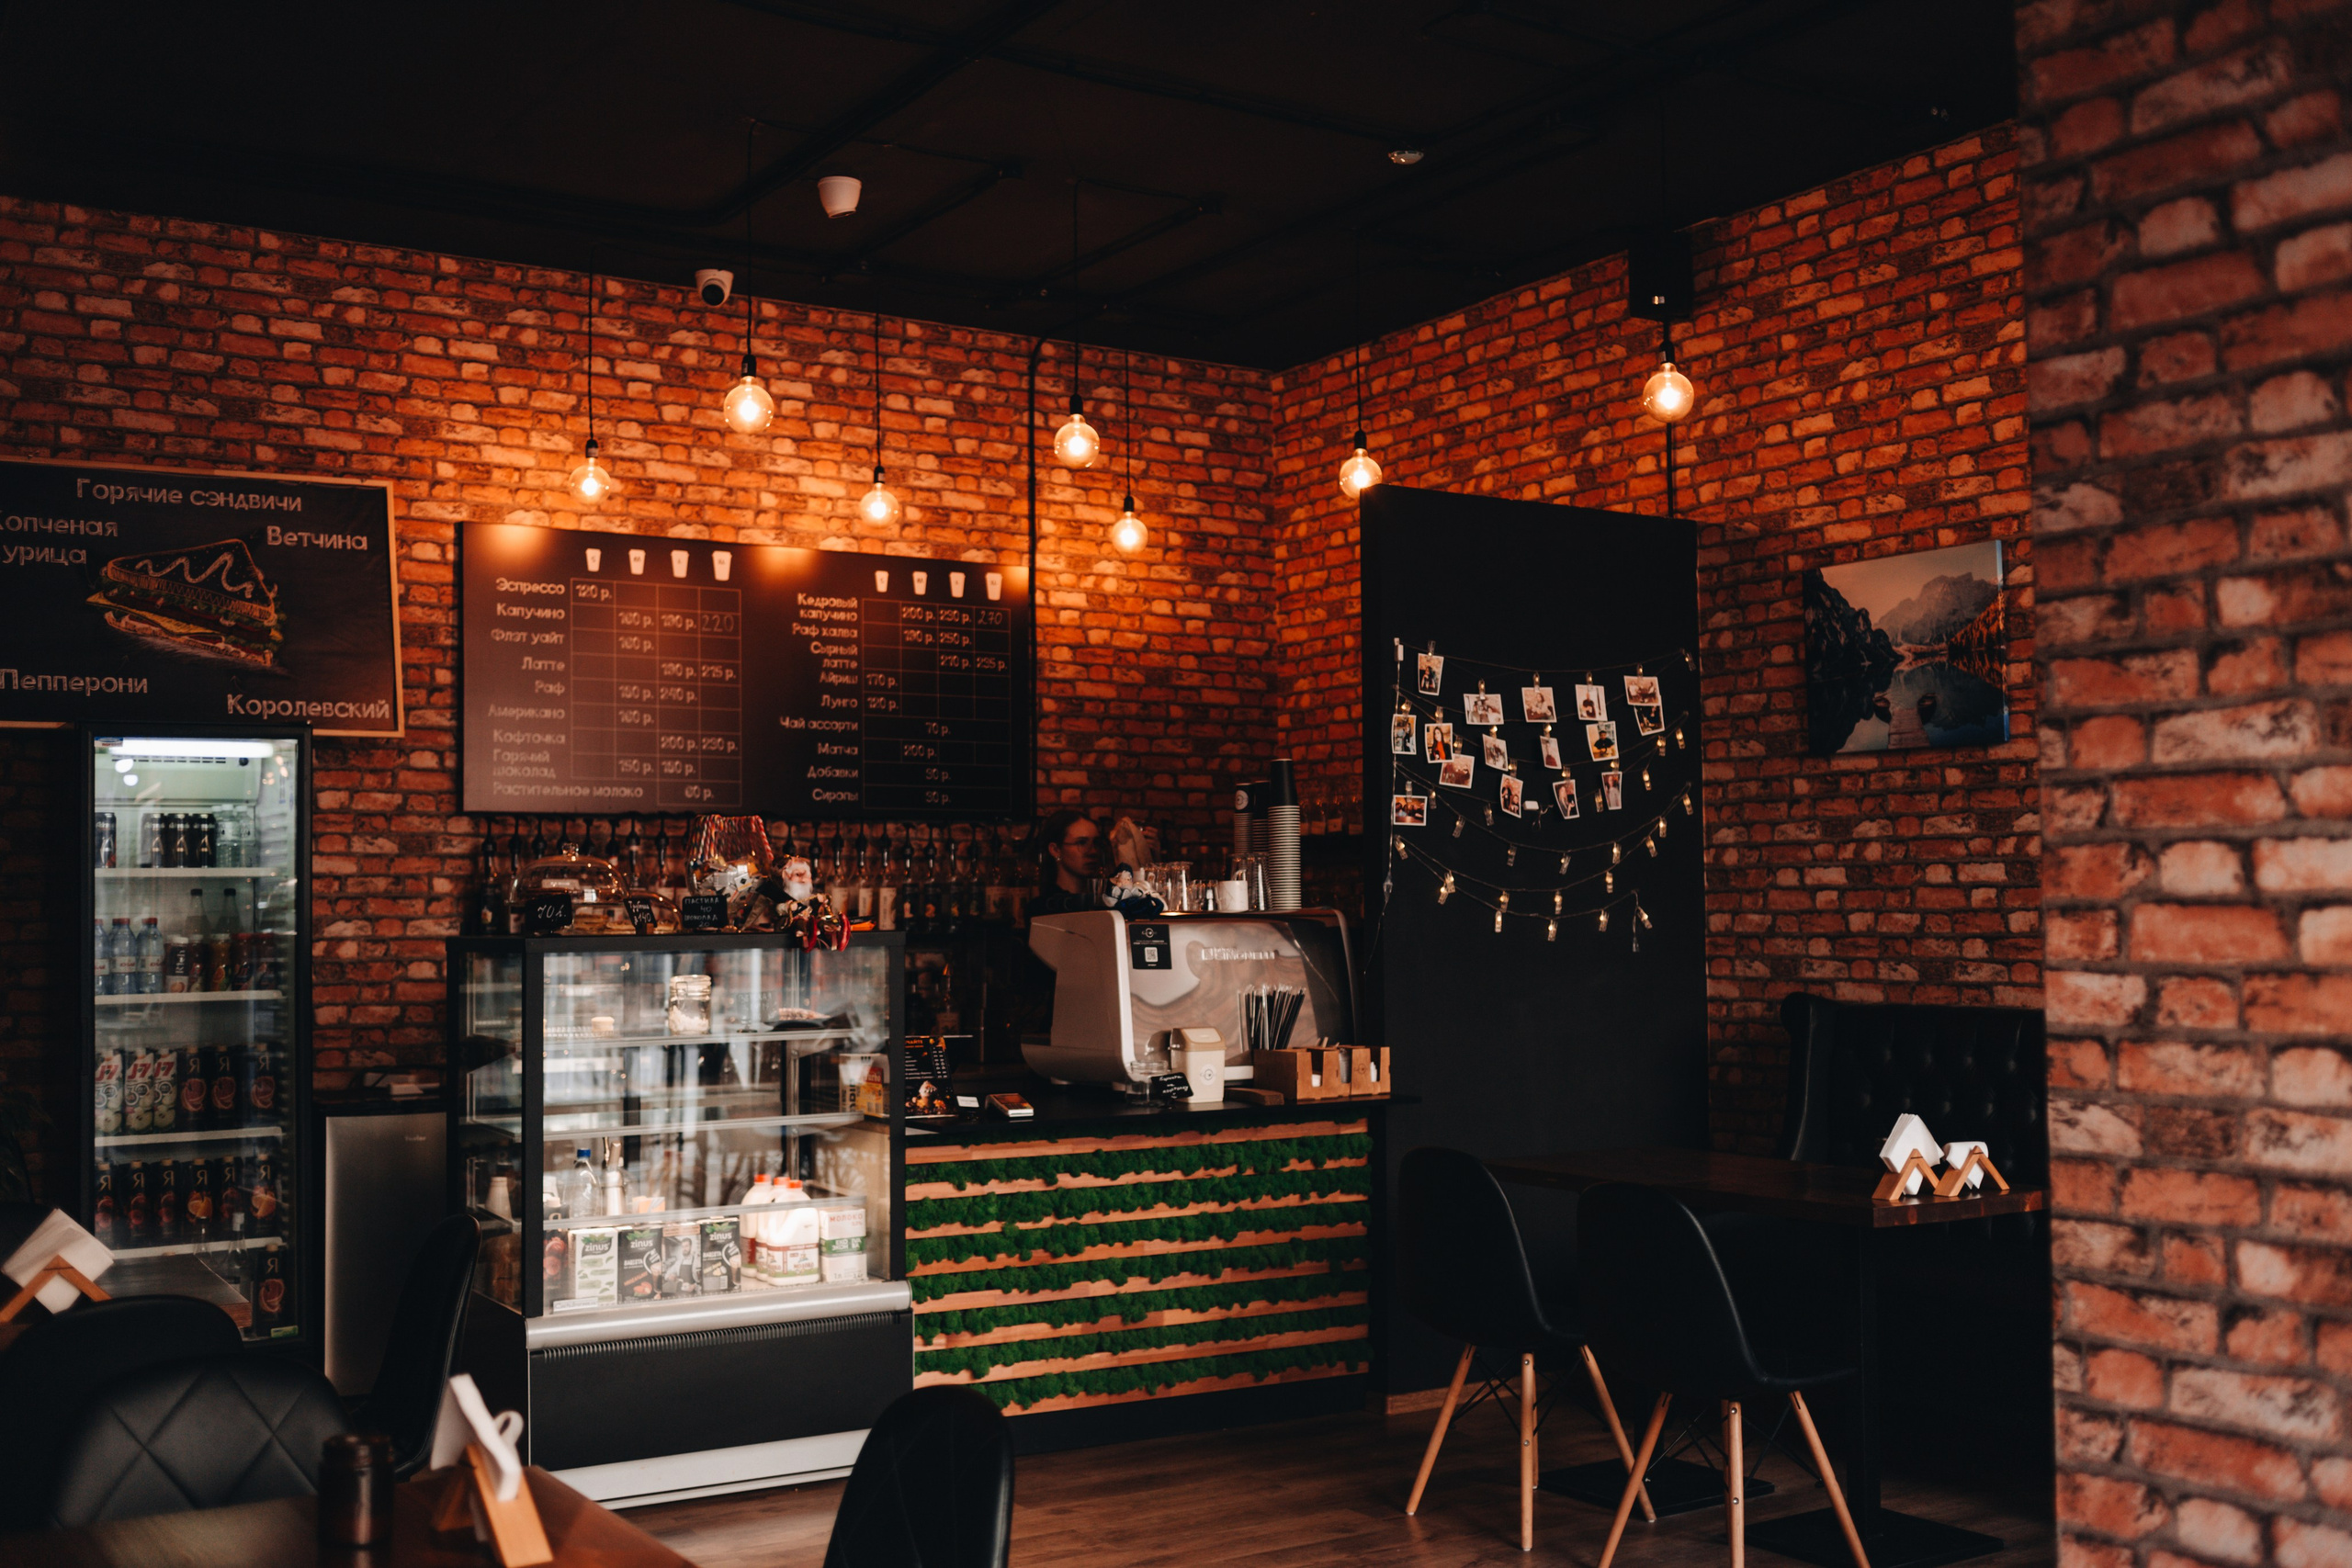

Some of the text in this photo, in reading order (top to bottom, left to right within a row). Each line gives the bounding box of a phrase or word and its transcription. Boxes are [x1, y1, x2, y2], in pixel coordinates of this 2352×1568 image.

[76, 478, 301, 513] Горячие сэндвичи
[266, 525, 368, 551] Ветчина
[0, 545, 86, 566] урица
[495, 577, 565, 595] Эспрессо
[575, 584, 598, 598] 120
[797, 593, 857, 609] Кедровый
[496, 604, 565, 620] Капучино
[799, 609, 857, 623] капучино
[902, 608, 924, 621] 200
[978, 610, 1003, 625] 270
[701, 615, 734, 632] 220
[792, 623, 858, 638] Раф халва
[491, 627, 565, 645] Флэт уайт
[810, 641, 857, 656] Сырный
[522, 657, 565, 671] Латте
[822, 658, 858, 670] латте
[0, 669, 148, 695] Пепперони
[820, 672, 858, 686] Айриш
[535, 681, 565, 696] Раф
[227, 694, 390, 720] Королевский
[821, 695, 858, 709] Лунго
[488, 704, 565, 721] Американо
[780, 717, 858, 733] Чай ассорти
[925, 722, 940, 734] 70
[661, 737, 684, 750] 200
[818, 743, 858, 756] Матча
[904, 744, 925, 757] 200
[492, 750, 549, 764] Горячий
[492, 766, 556, 779] шоколад
[807, 766, 858, 779] Добавки
[492, 783, 643, 798] Растительное молоко
[812, 788, 858, 802] Сиропы
[537, 905, 555, 919] 70
[187, 1058, 200, 1074] Я
[219, 1056, 230, 1072] Я
[259, 1054, 270, 1071] Я
[132, 1172, 145, 1188] Я
[162, 1170, 175, 1186] Я
[196, 1169, 209, 1185] Я
[224, 1167, 236, 1182] Я
[259, 1165, 271, 1180] Я
[99, 1175, 112, 1191] Я
[830, 1213, 863, 1222] МОЛОКО
[630, 1240, 653, 1248] zinus
[709, 1232, 731, 1241] zinus
[585, 1243, 609, 1251] zinus
[266, 1258, 279, 1274] Я
